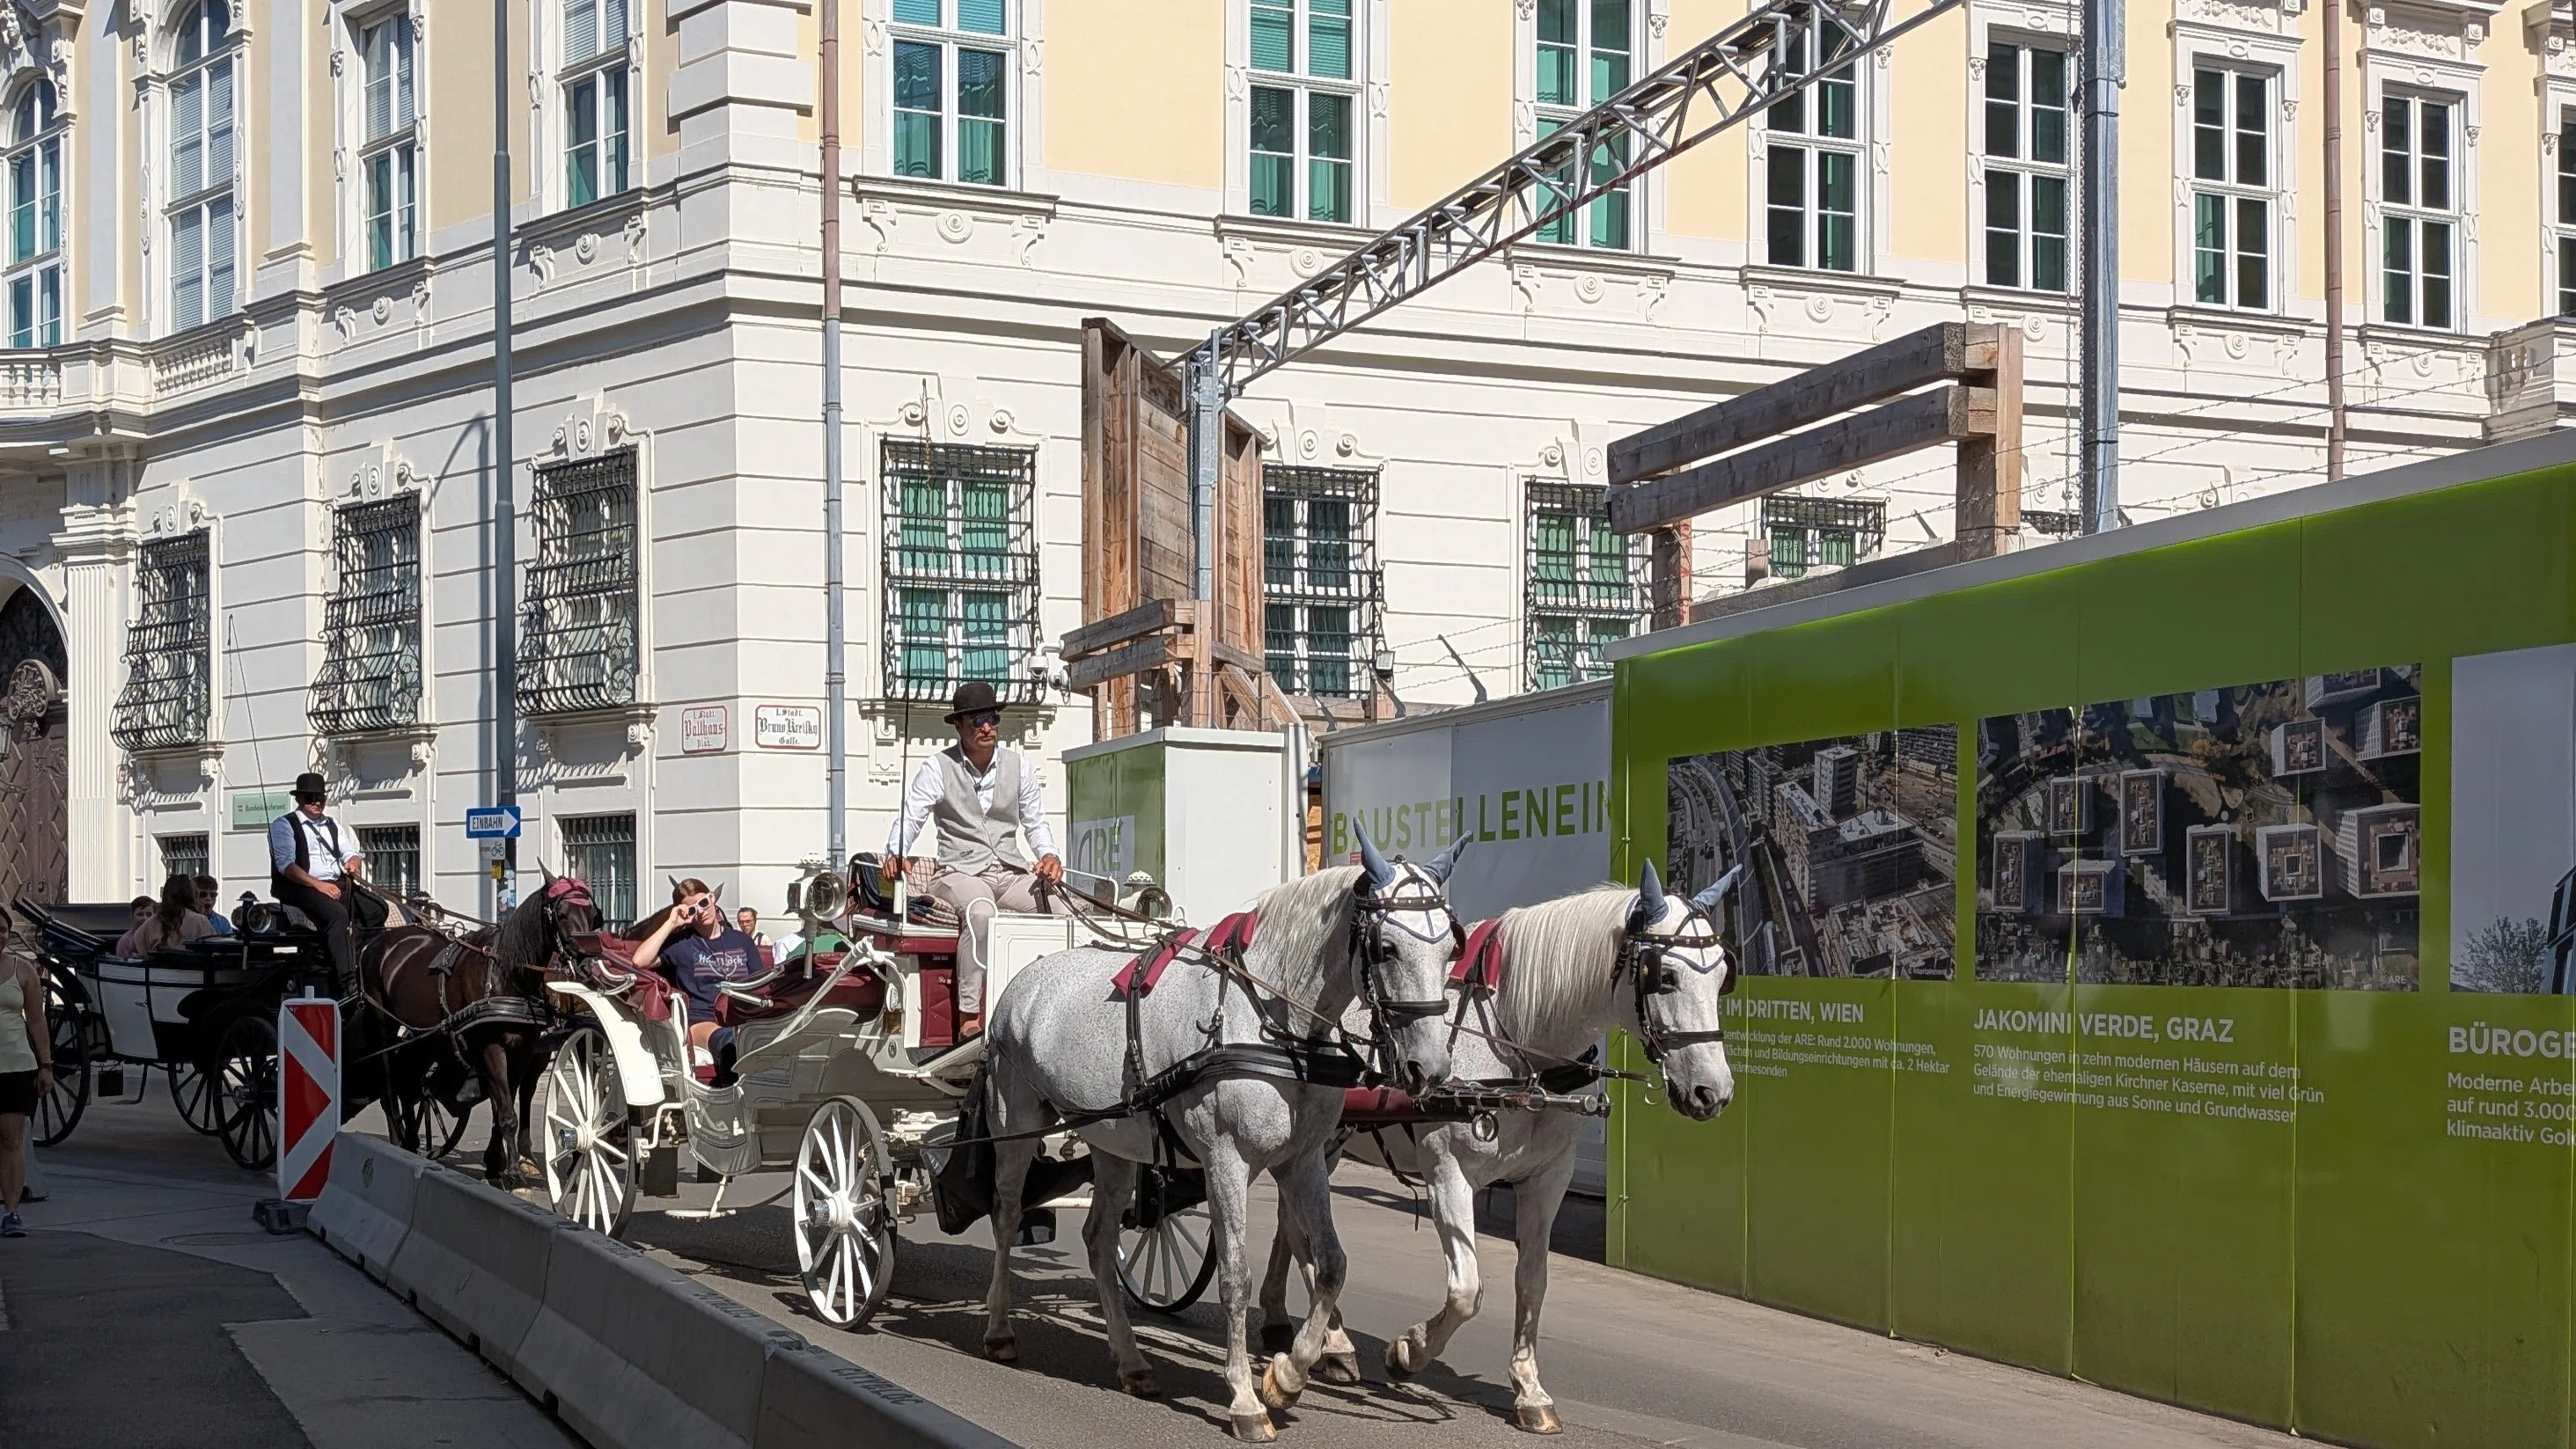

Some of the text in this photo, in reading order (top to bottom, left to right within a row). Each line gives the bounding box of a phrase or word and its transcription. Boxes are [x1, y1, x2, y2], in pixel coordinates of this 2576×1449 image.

[758, 717, 786, 735] Bruno
[472, 816, 503, 830] EINBAHN
[2389, 975, 2406, 984] ARE
[1727, 999, 1742, 1016] IM
[1748, 999, 1815, 1024] DRITTEN,
[1819, 1002, 1864, 1023] WIEN
[1974, 1008, 2235, 1043] JAKOMINI VERDE, GRAZ
[1723, 1029, 1776, 1045] sentwcklung
[1778, 1032, 1792, 1044] der
[1818, 1035, 1841, 1048] Rund
[1843, 1036, 1871, 1050] 2.000
[1874, 1038, 1936, 1056] Wohnungen,
[2449, 1021, 2576, 1059] BÜROGE
[1755, 1048, 1770, 1059] und
[1772, 1048, 1870, 1069] Bildungseinrichtungen
[1873, 1057, 1889, 1069] mit
[1890, 1060, 1904, 1070] ca.
[1907, 1058, 1913, 1071] 2
[1916, 1058, 1950, 1074] Hektar
[1973, 1044, 2301, 1079] 570 Wohnungen in zehn modernen Häusern auf dem
[1973, 1063, 2324, 1104] Gelände der ehemaligen Kirchner Kaserne, mit viel Grün
[2448, 1072, 2523, 1093] Moderne
[1973, 1083, 2296, 1123] und Energiegewinnung aus Sonne und Grundwasser
[2447, 1096, 2474, 1113] auf
[2478, 1100, 2518, 1117] rund
[2447, 1119, 2535, 1143] klimaaktiv
